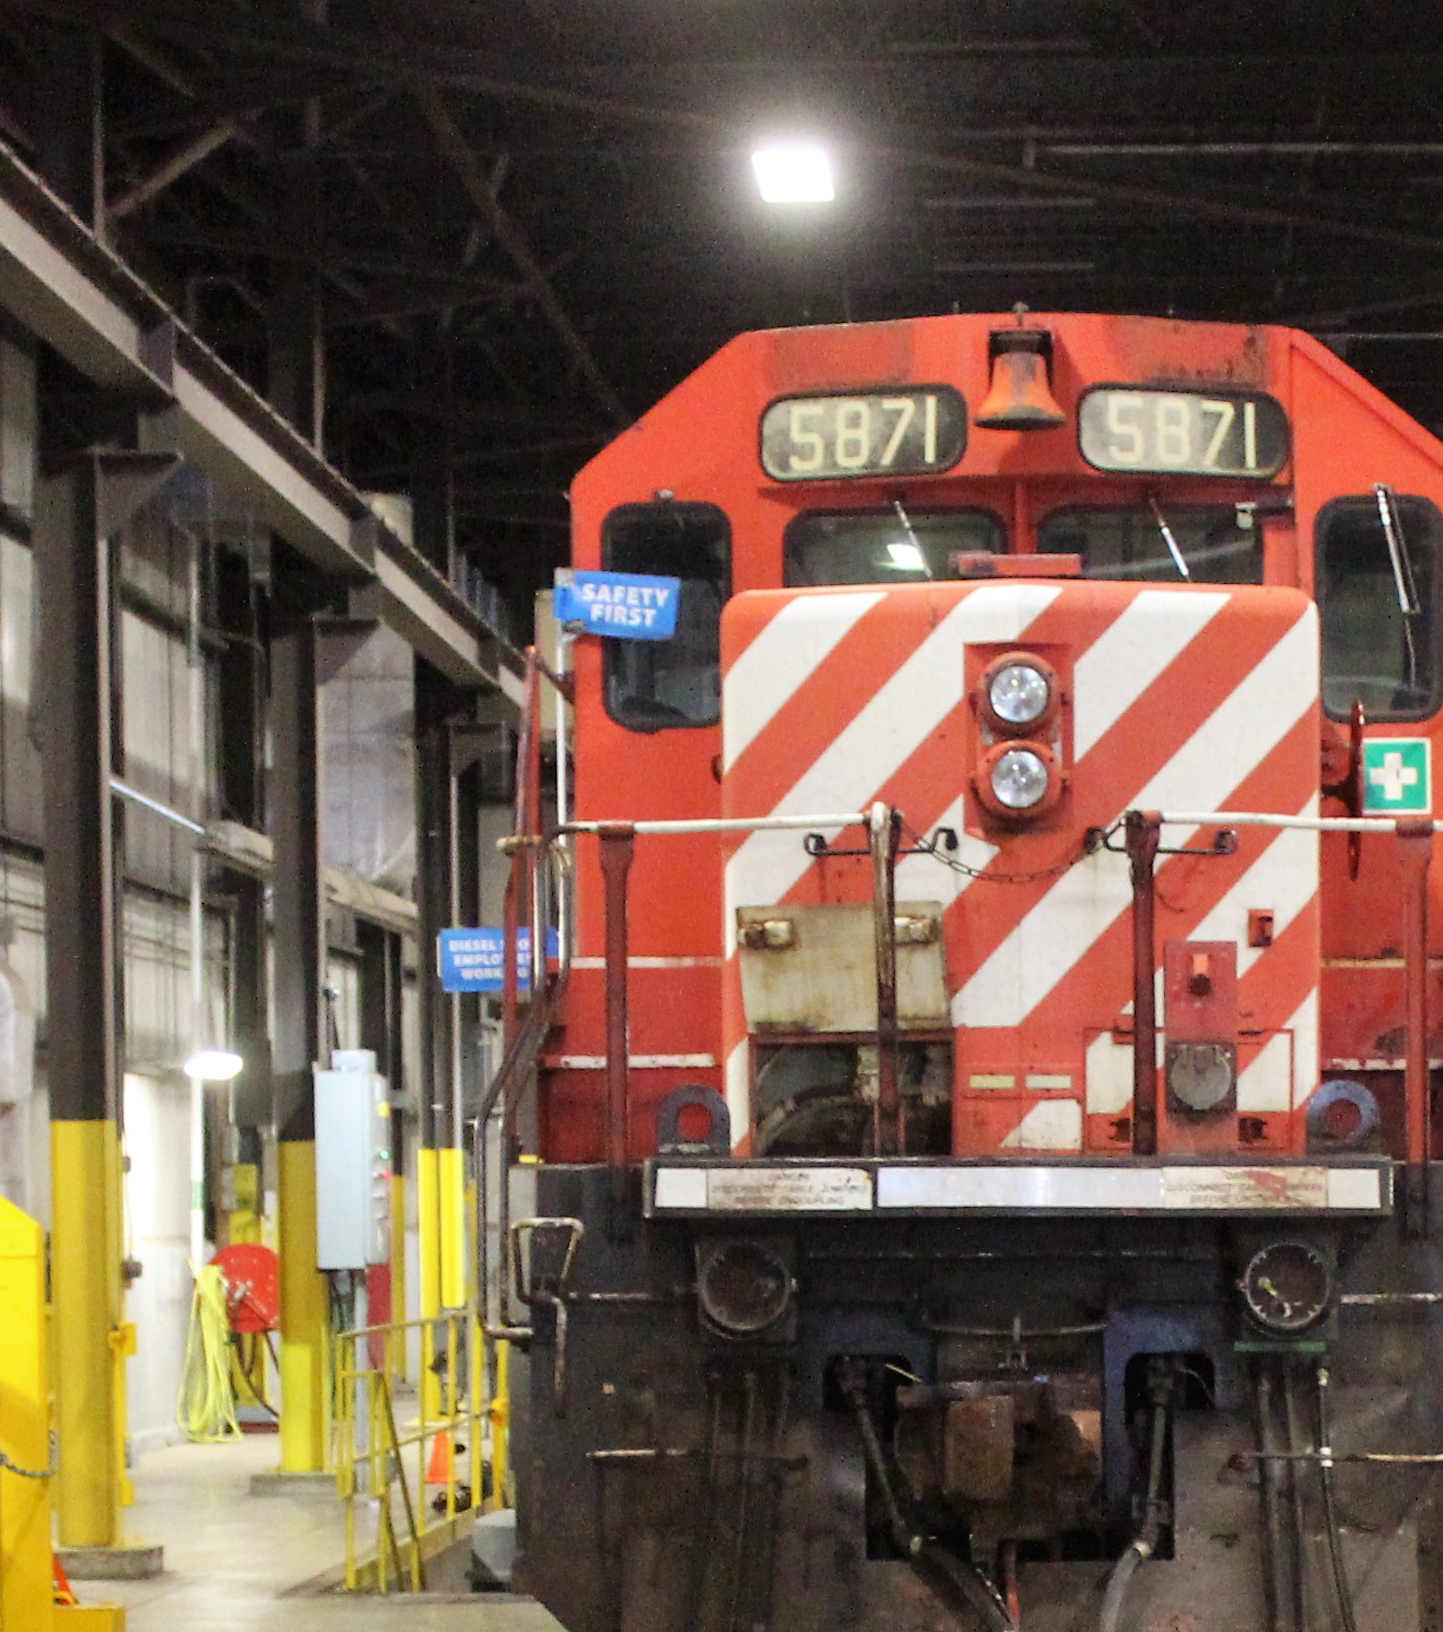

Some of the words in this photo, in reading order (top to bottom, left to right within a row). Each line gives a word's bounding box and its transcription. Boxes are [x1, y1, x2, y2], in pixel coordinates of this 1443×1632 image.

[788, 395, 937, 471] 5871
[1107, 396, 1257, 470] 5871
[581, 582, 670, 608] SAFETY
[590, 603, 657, 627] FIRST
[449, 939, 496, 952] DIESEL
